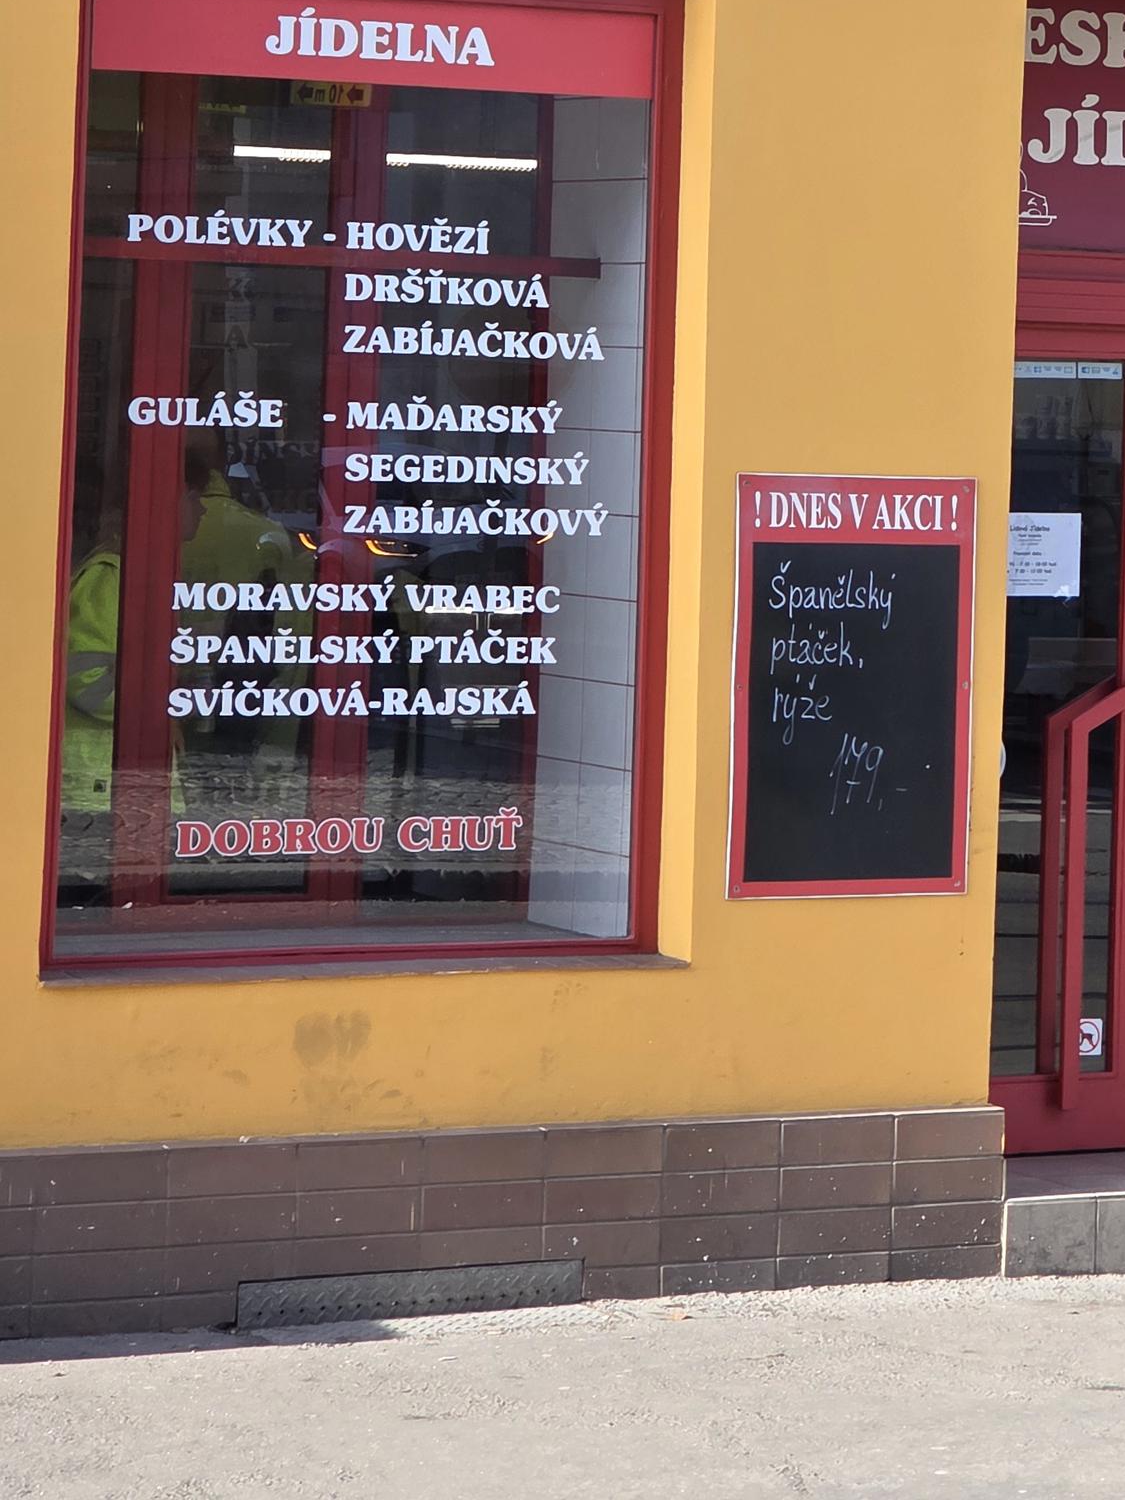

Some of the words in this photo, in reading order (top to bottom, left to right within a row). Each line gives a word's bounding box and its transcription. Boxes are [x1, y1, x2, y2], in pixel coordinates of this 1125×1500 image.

[265, 7, 495, 66] JÍDELNA
[127, 210, 312, 248] POLÉVKY
[345, 218, 490, 256] HOVĚZÍ
[344, 268, 550, 309] DRŠŤKOVÁ
[342, 321, 605, 362] ZABÍJAČKOVÁ
[128, 391, 284, 428] GULÁŠE
[345, 396, 563, 434] MAĎARSKÝ
[344, 452, 590, 486] SEGEDINSKÝ
[342, 500, 609, 537] ZABÍJAČKOVÝ
[768, 491, 842, 530] DNES
[848, 493, 869, 529] V
[872, 494, 944, 531] AKCI
[171, 576, 395, 613] MORAVSKÝ
[404, 584, 562, 614] VRABEC
[769, 560, 896, 630] Španělský
[169, 628, 400, 665] ŠPANĚLSKÝ
[409, 629, 557, 664] PTÁČEK
[770, 622, 864, 674] ptáček,
[772, 674, 832, 745] rýže
[175, 815, 384, 858] DOBROU
[397, 806, 524, 852] CHUŤ
